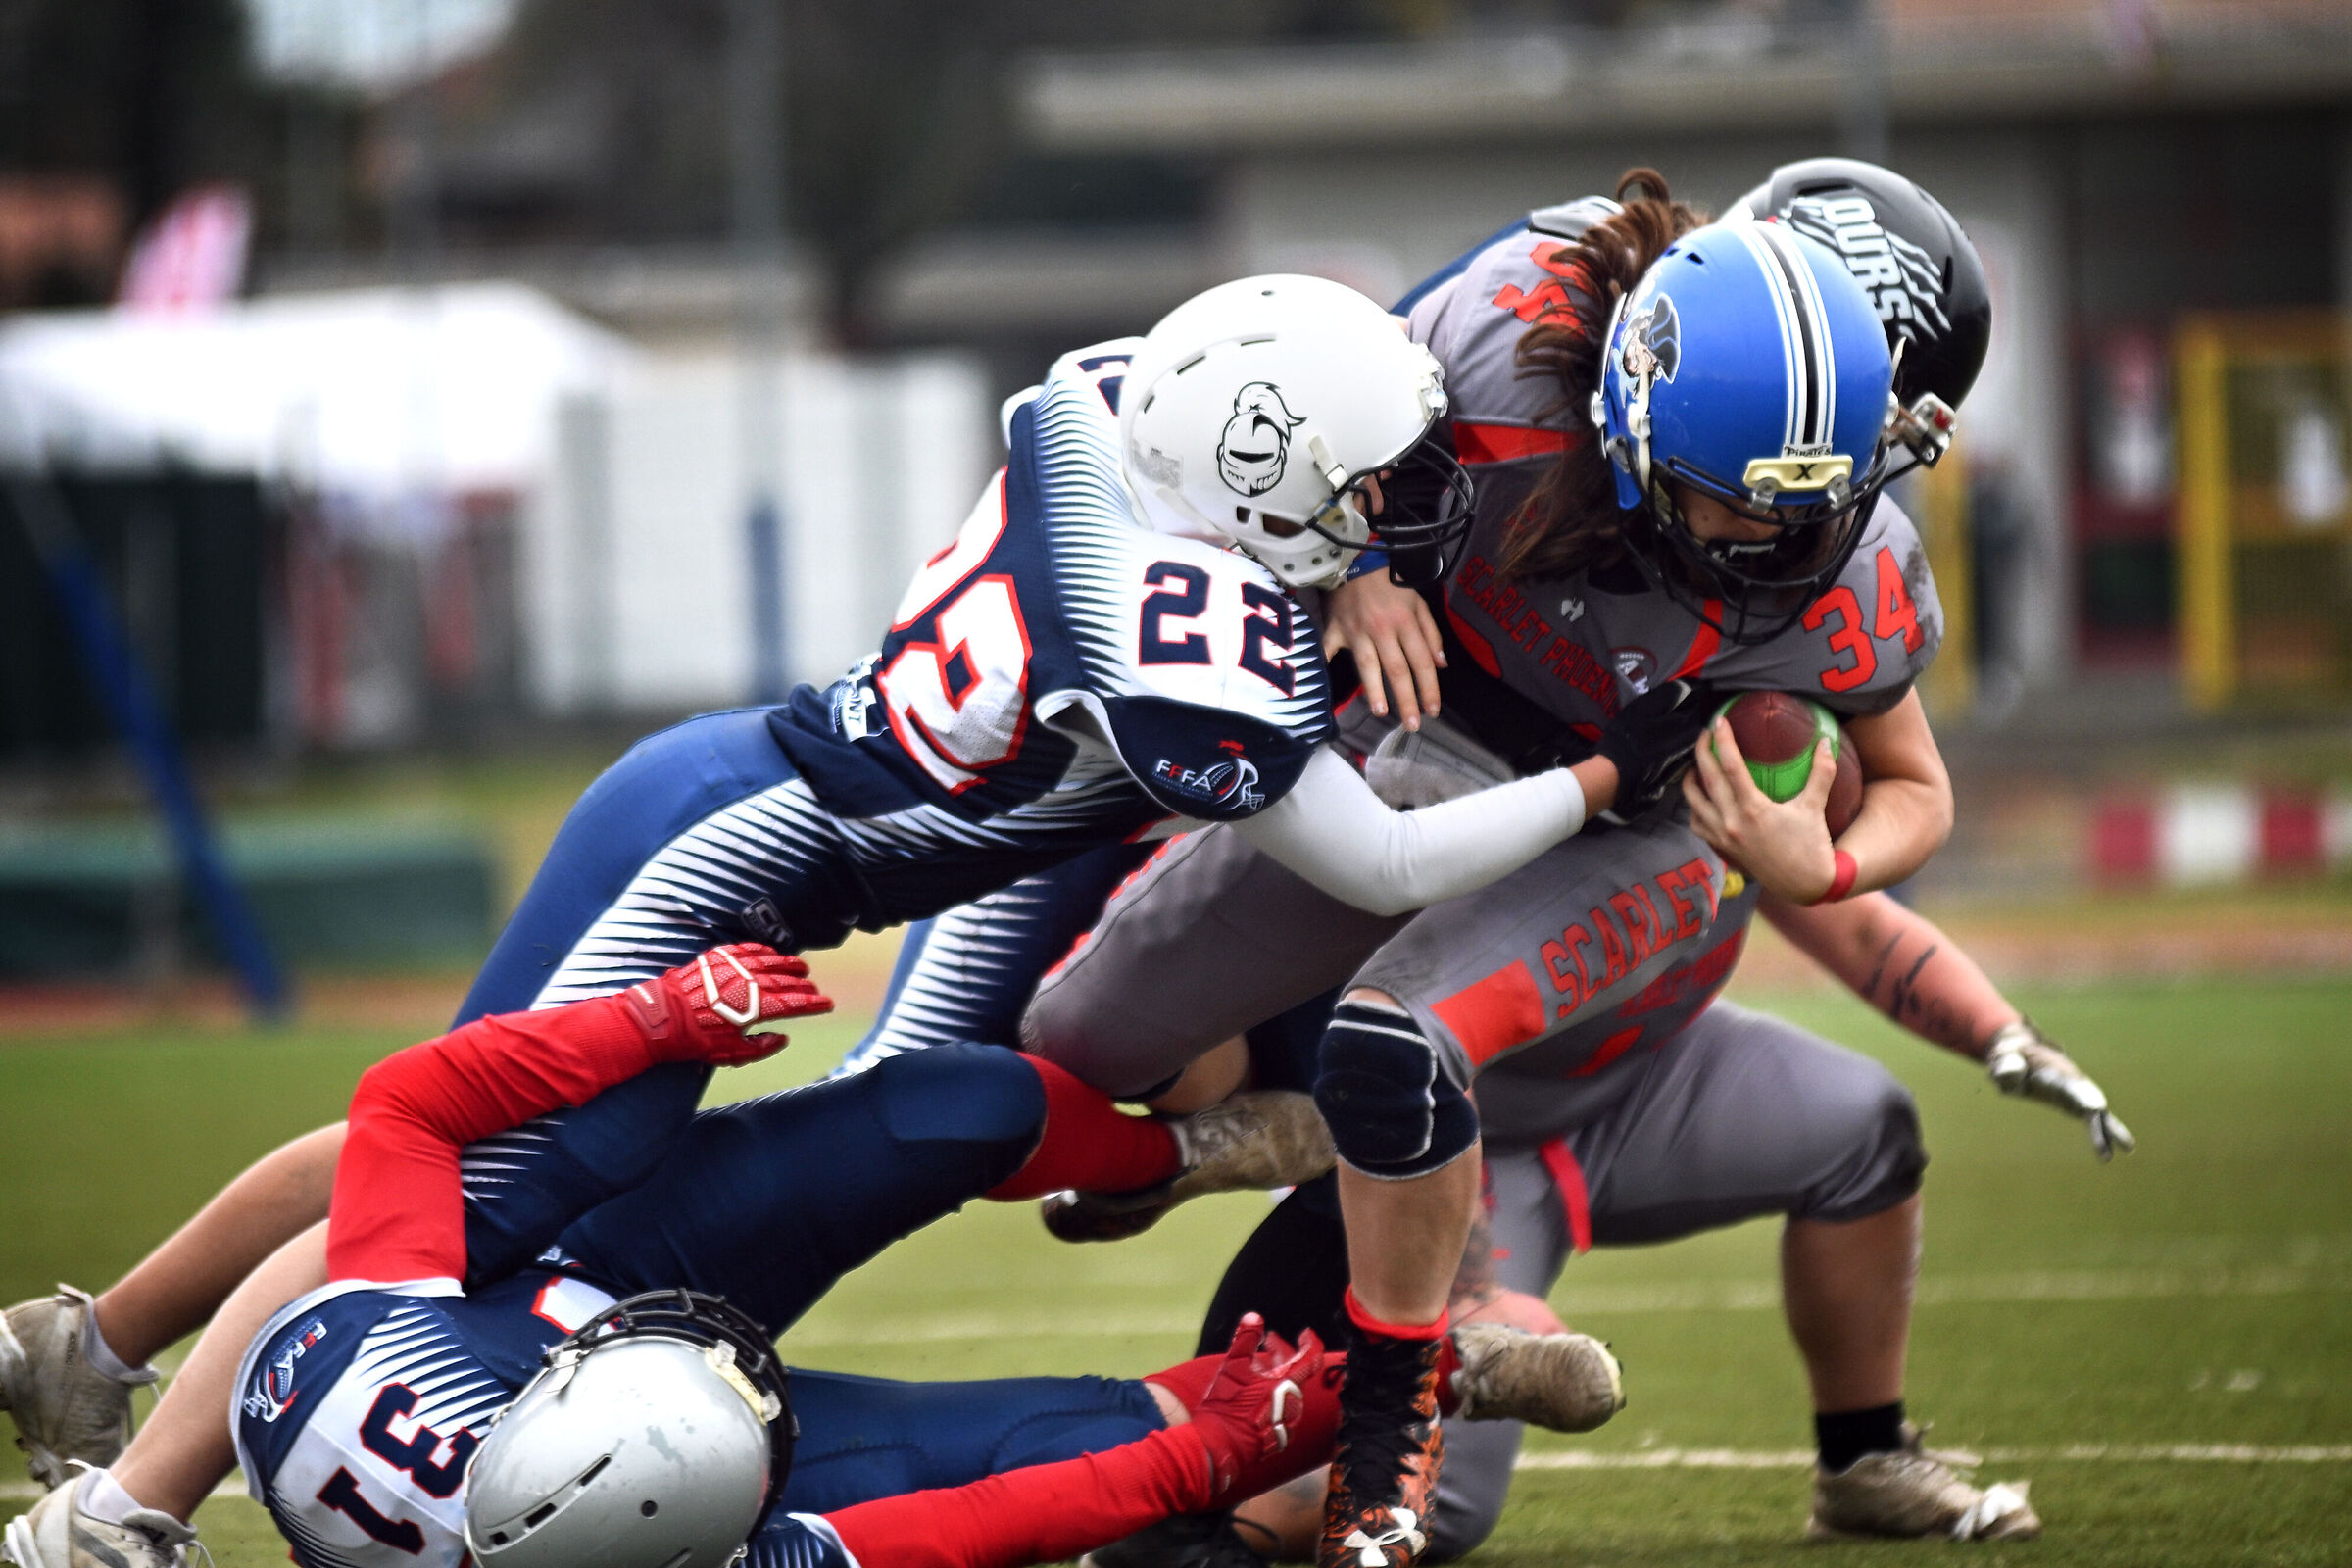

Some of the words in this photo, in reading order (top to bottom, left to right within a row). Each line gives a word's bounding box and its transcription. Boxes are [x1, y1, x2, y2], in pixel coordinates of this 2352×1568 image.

[1823, 197, 1914, 321] OURS
[1792, 463, 1818, 481] X
[1138, 560, 1298, 699] 22
[1456, 556, 1552, 653] SCARLET
[1802, 545, 1926, 693] 34
[1155, 759, 1213, 792] FFFA
[1540, 857, 1719, 1019] SCARLET
[316, 1381, 480, 1556] 31
